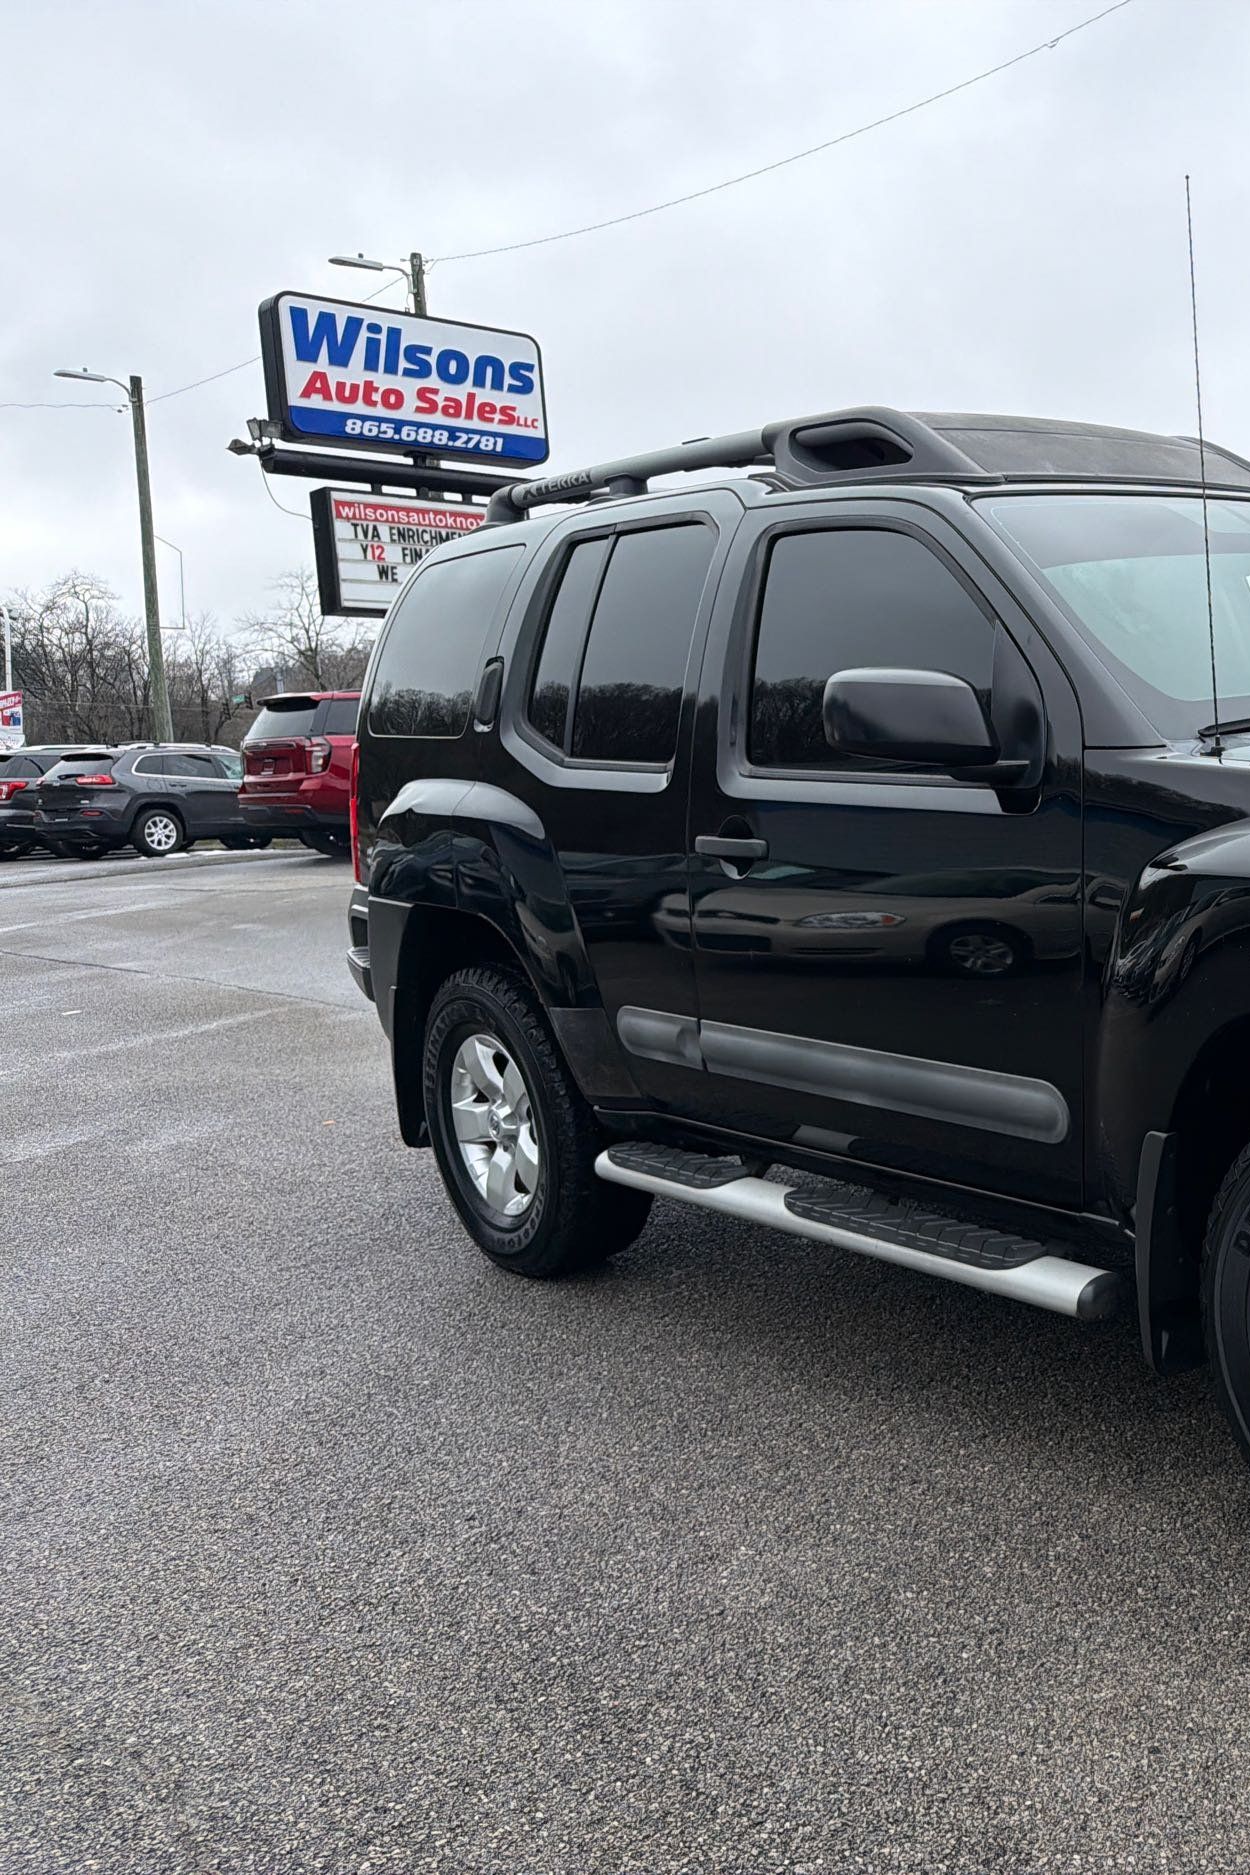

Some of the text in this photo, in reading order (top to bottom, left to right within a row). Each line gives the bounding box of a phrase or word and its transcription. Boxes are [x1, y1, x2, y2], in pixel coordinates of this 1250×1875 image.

[289, 305, 535, 395] Wilsons
[299, 371, 538, 429] Auto Sales LLC
[344, 418, 503, 452] 865.688.2781
[351, 523, 382, 541] TVA
[360, 543, 386, 562] Y12
[377, 564, 399, 583] WE
